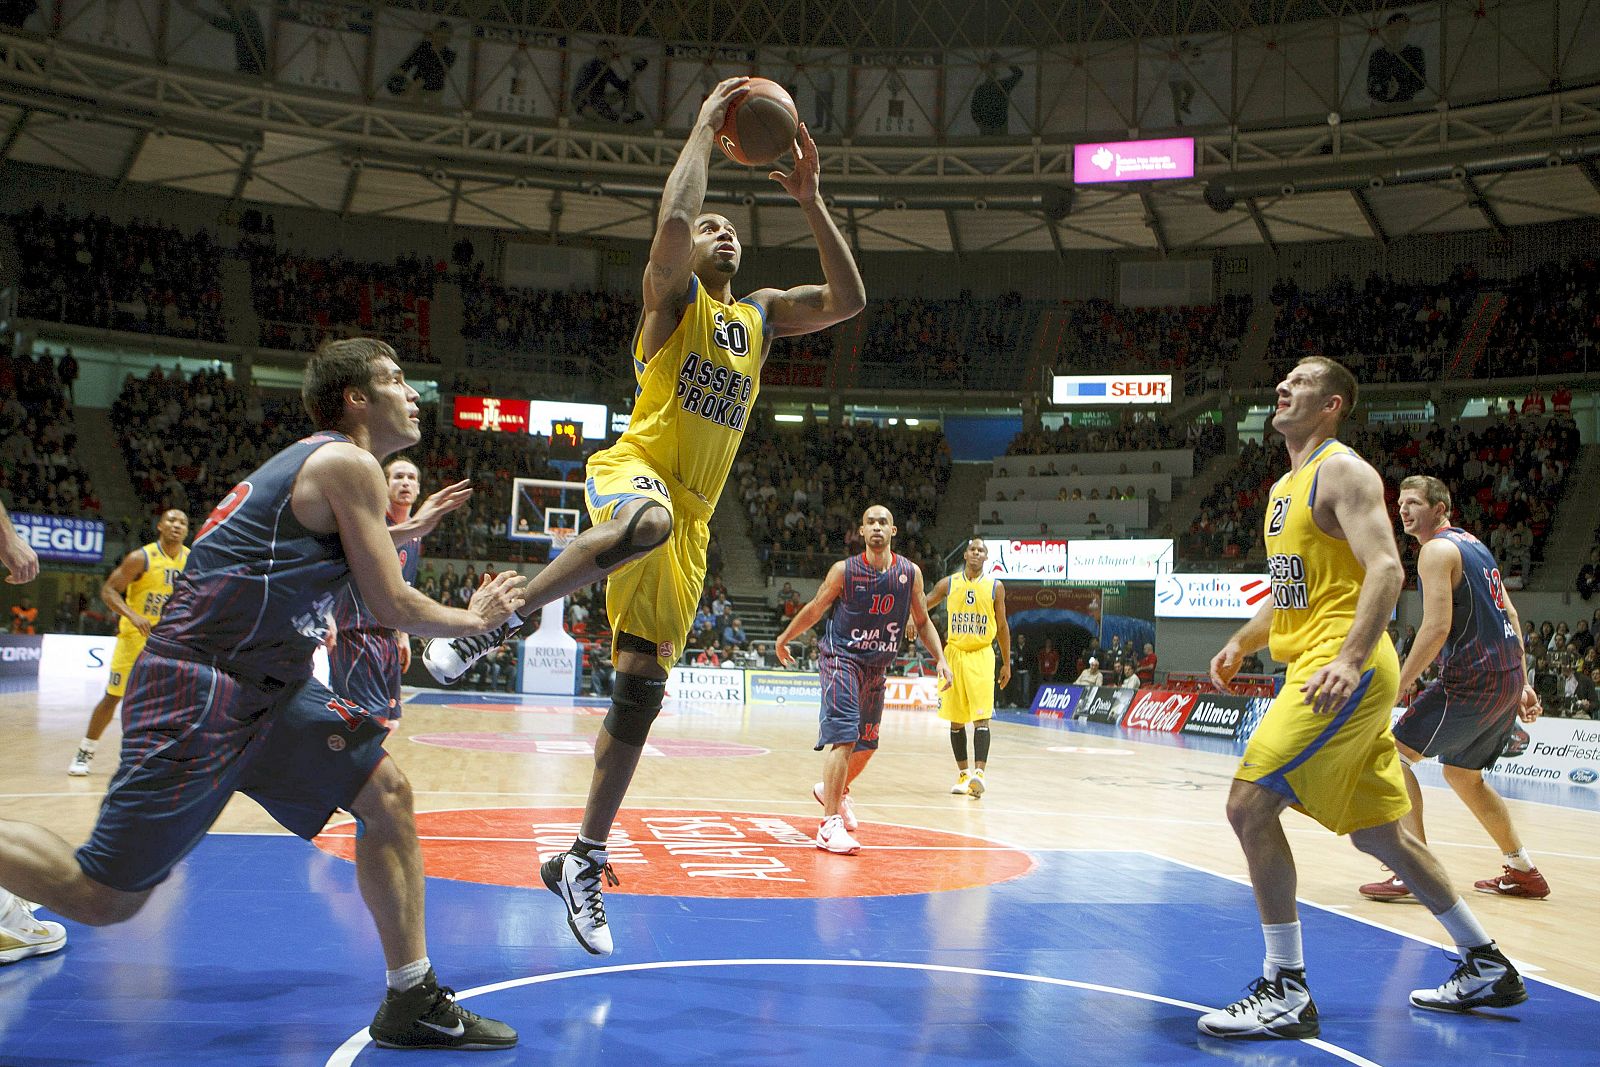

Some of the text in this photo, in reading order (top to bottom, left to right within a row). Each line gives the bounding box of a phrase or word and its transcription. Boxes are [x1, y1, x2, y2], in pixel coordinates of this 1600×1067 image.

[714, 312, 749, 357] 30
[1111, 381, 1166, 396] SEUR
[630, 475, 671, 503] 30
[11, 514, 104, 531] LUMINOSOS
[1189, 578, 1231, 591] radio
[869, 594, 894, 615] 10
[966, 590, 976, 605] 5
[1189, 594, 1241, 607] vitoria
[952, 613, 987, 624] ASSECO
[851, 628, 880, 641] CAJA
[952, 624, 986, 635] PROKOM
[535, 647, 567, 657] RIOJA
[527, 657, 573, 669] ALAVESA
[680, 671, 739, 686] HOTEL
[677, 688, 741, 701] HOGAR
[755, 685, 788, 696] VIAJES
[1038, 687, 1071, 709] Diario
[1191, 702, 1239, 725] Alimco
[1504, 763, 1561, 780] Moderno
